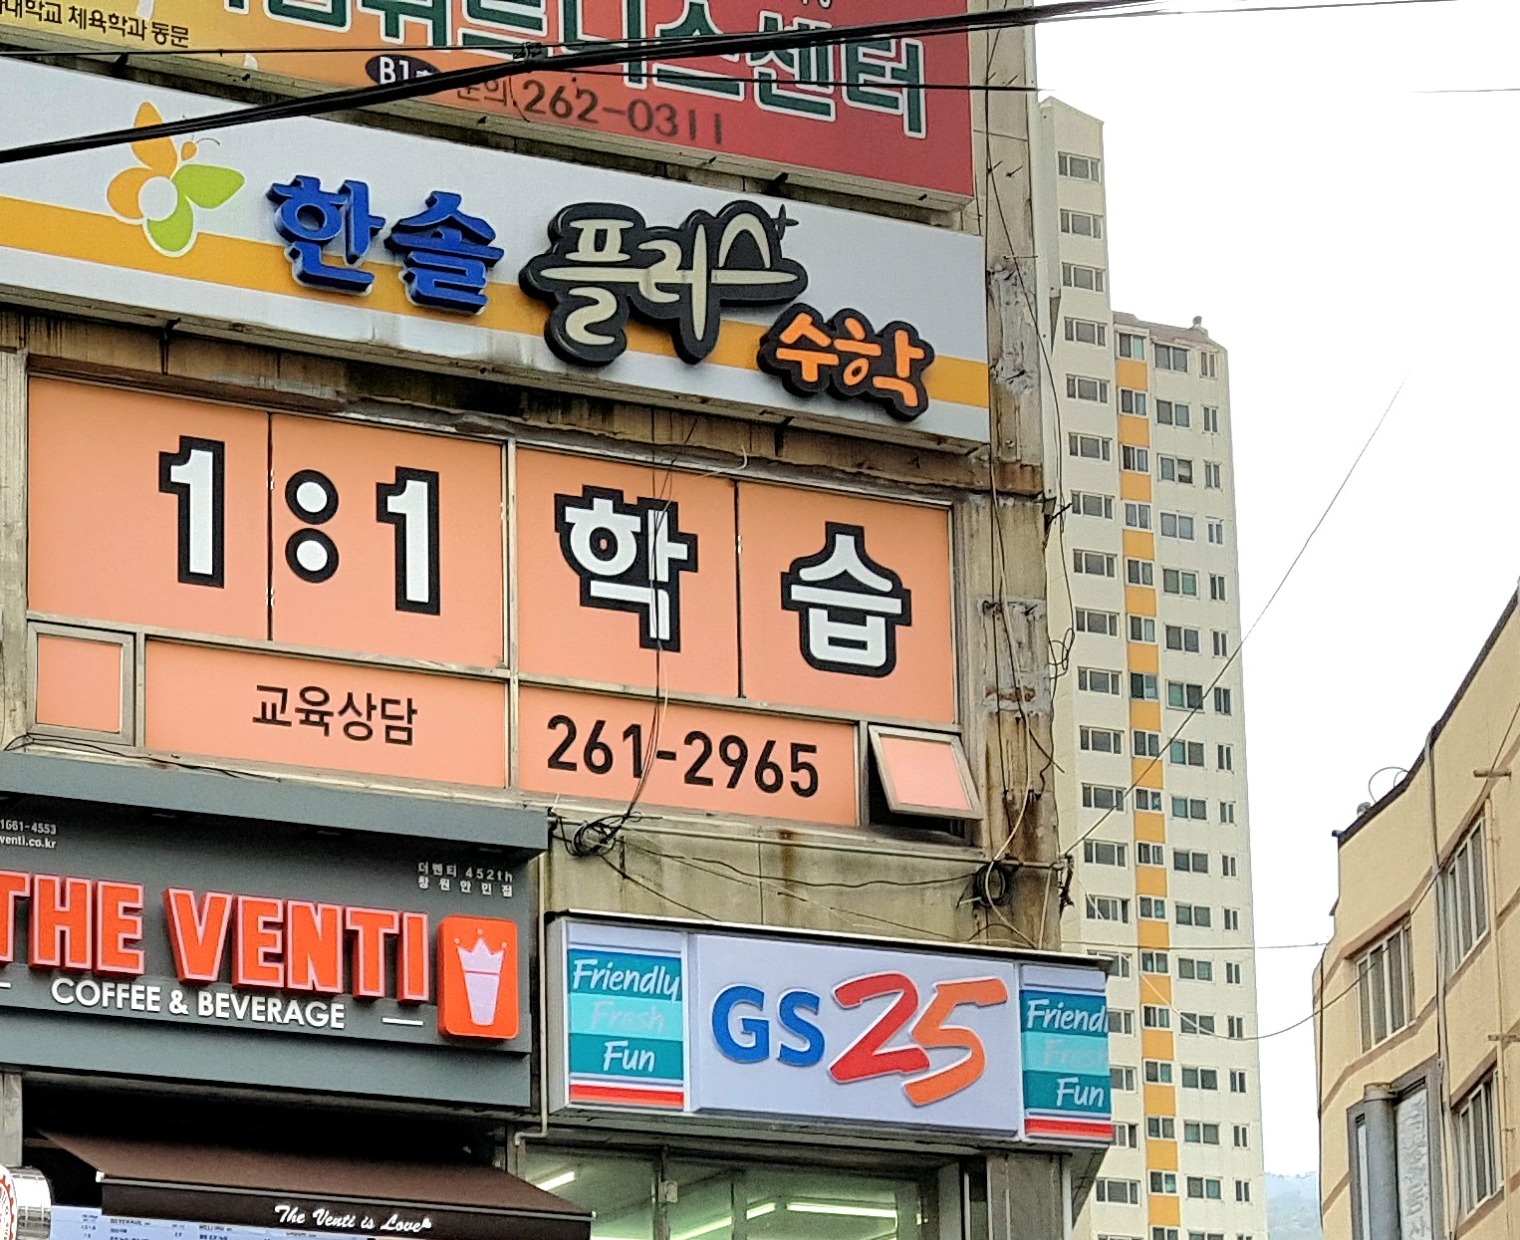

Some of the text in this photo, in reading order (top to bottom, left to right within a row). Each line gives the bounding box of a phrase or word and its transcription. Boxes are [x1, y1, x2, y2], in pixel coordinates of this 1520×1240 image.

[68, 5, 147, 41] 체육학과
[151, 21, 190, 48] 동문
[380, 56, 435, 85] B1
[522, 80, 724, 146] 262-0311
[266, 171, 505, 315] 한솔
[757, 302, 936, 423] 수학
[158, 435, 912, 678] 1:1 학습
[251, 683, 819, 799] 교육상담 261-2965
[0, 819, 56, 834] 1661-4553
[465, 867, 512, 882] 452th
[163, 887, 430, 1005] VENTI
[51, 977, 345, 1030] COFFEE & BEVERAGE
[572, 960, 681, 1002] Friendly
[603, 1041, 656, 1073] Fun
[711, 971, 1008, 1108] GS25
[1056, 1077, 1105, 1107] Fun
[275, 1204, 422, 1234] The Venti is Love
